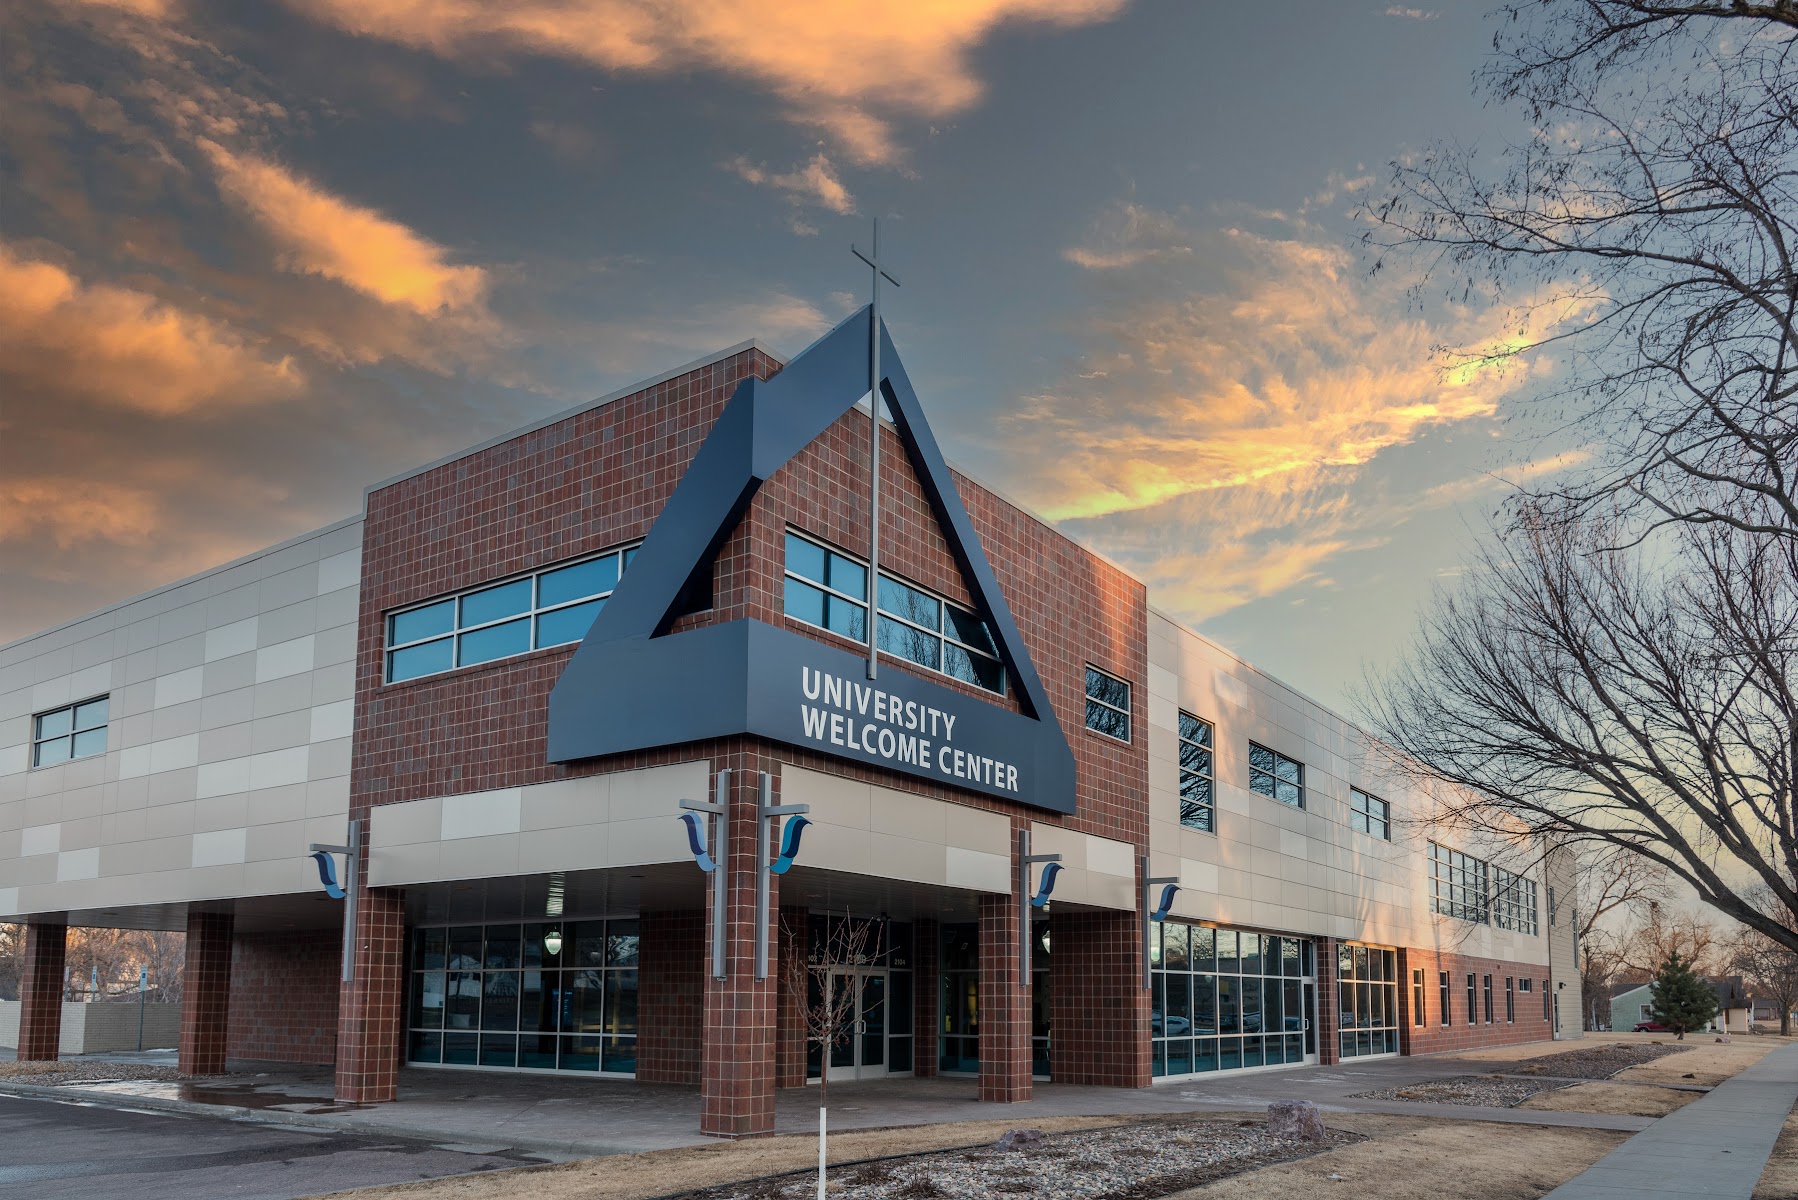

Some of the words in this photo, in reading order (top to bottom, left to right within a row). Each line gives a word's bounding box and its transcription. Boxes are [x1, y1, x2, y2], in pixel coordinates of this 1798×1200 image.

[802, 666, 956, 741] UNIVERSITY
[801, 704, 931, 769] WELCOME
[938, 746, 1019, 793] CENTER
